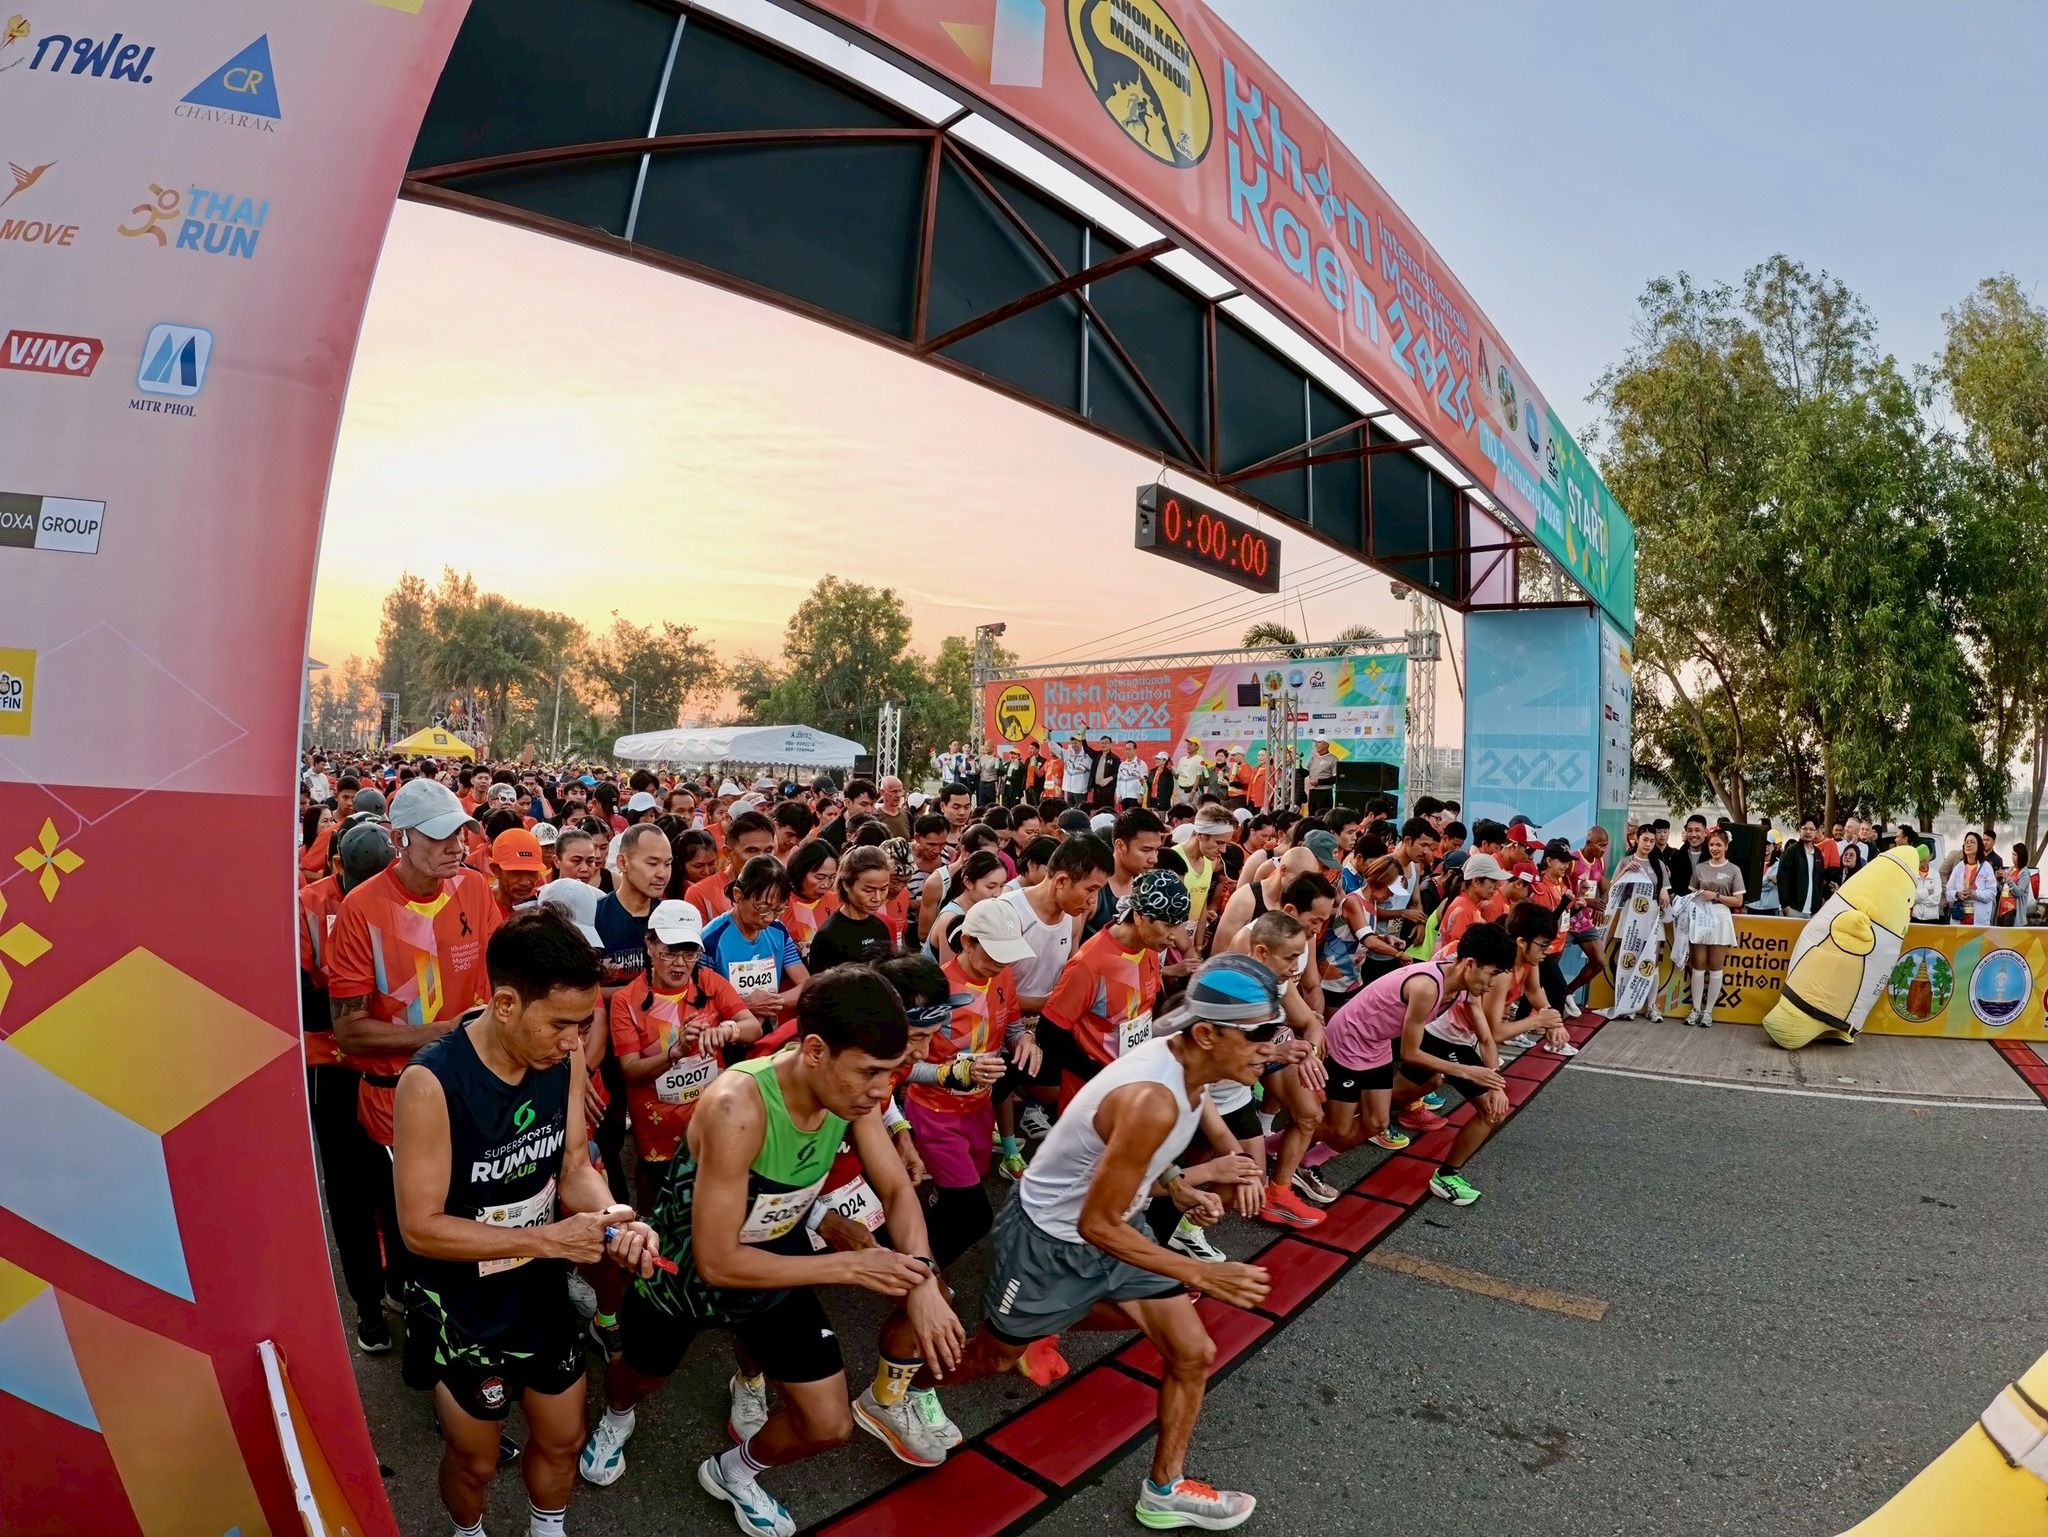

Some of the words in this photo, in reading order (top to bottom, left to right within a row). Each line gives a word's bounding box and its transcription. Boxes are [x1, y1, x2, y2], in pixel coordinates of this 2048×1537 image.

[1111, 16, 1191, 98] MARATHON
[1155, 24, 1190, 68] KAEN
[223, 68, 263, 95] CR
[174, 105, 276, 133] CHAVARAK
[187, 189, 270, 228] THAI
[176, 220, 260, 259] RUN
[1228, 138, 1379, 344] Kaen
[1381, 246, 1472, 373] Marathon
[1387, 300, 1475, 432] 2026
[128, 398, 162, 413] MITR
[164, 403, 197, 418] PHOL
[1501, 442, 1542, 519] January
[1543, 491, 1562, 534] 2026
[42, 516, 98, 535] GROUP
[1567, 476, 1604, 558] START
[1165, 500, 1267, 576] 0:00:00
[1106, 688, 1171, 702] Marathon
[1044, 705, 1101, 730] Kaen
[1106, 701, 1171, 729] 2026
[1477, 749, 1584, 790] 2026
[739, 971, 772, 988] 50423
[666, 1066, 709, 1089] 50207
[684, 1089, 699, 1100] F60
[484, 1124, 552, 1159] SUPERSPORTS
[504, 1161, 537, 1184] CLUB
